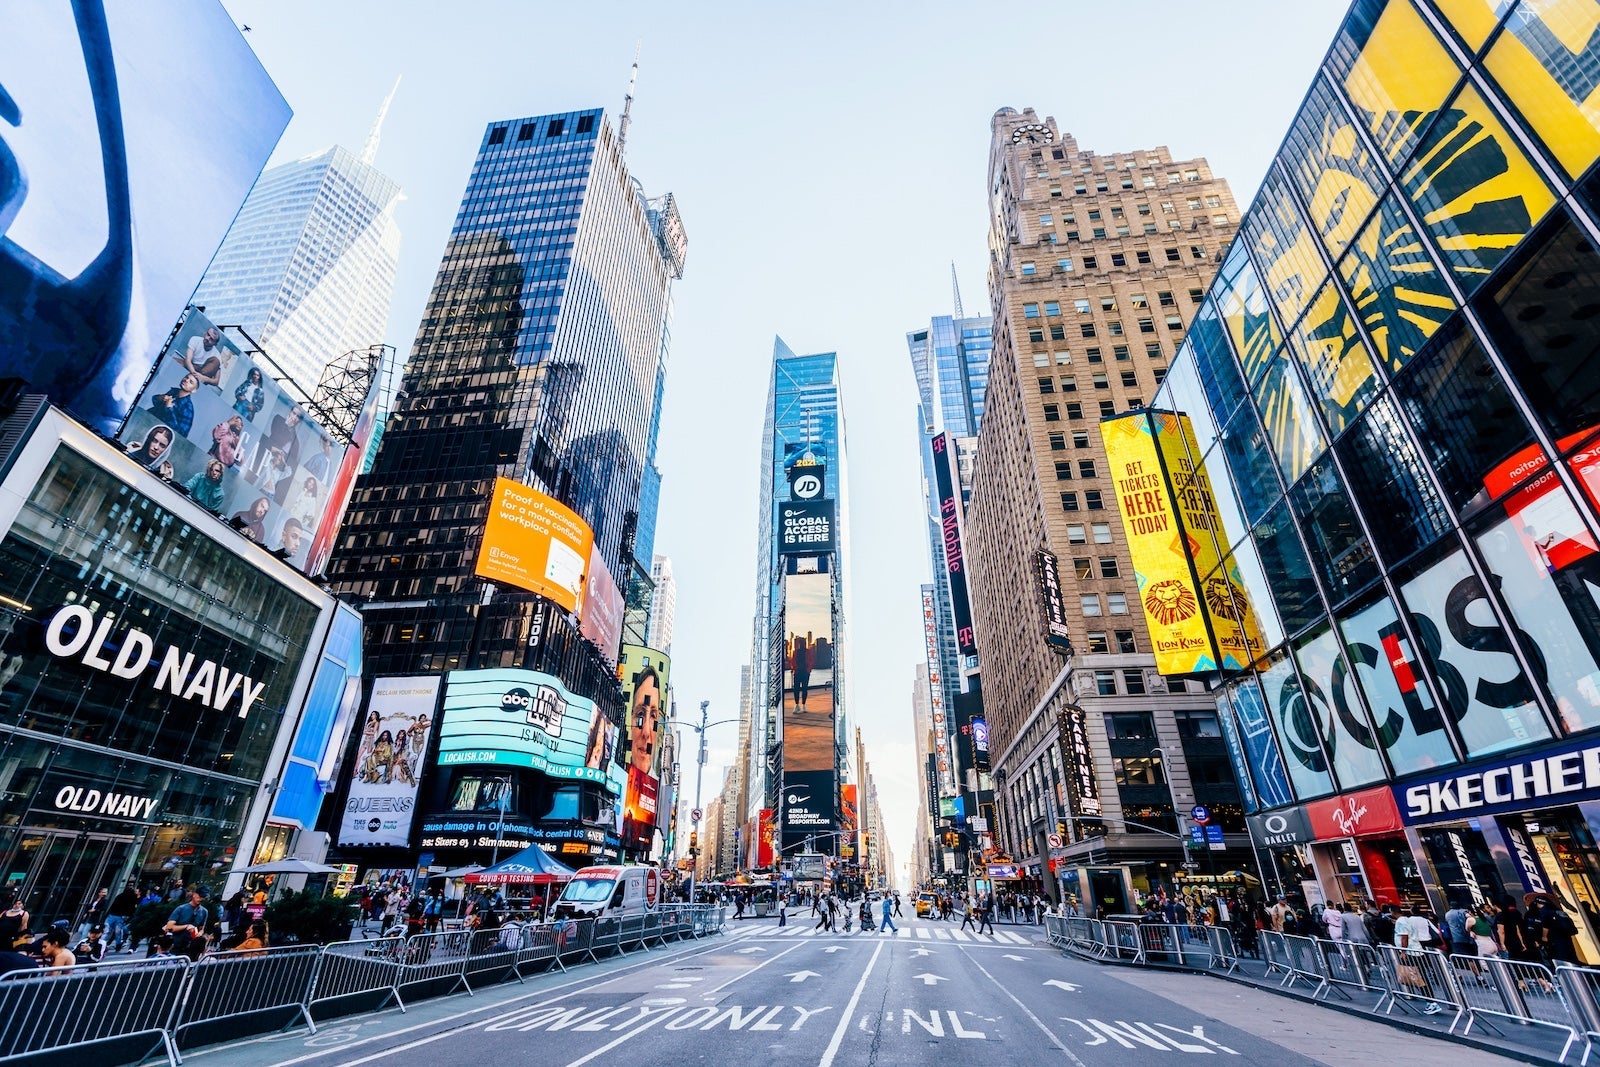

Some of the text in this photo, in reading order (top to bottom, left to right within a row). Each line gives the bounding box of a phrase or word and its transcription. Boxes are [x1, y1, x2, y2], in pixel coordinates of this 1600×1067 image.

[234, 431, 272, 477] GAP
[1126, 460, 1143, 476] GET
[798, 481, 817, 493] JD
[1118, 474, 1160, 494] TICKETS
[504, 489, 583, 536] Proof of vaccination
[1123, 489, 1166, 518] HERE
[500, 511, 549, 535] workplace
[501, 499, 517, 511] for
[527, 511, 551, 525] more
[552, 522, 582, 546] confident
[784, 517, 829, 526] GLOBAL
[784, 525, 829, 535] ACCESS
[1129, 513, 1169, 536] TODAY
[785, 533, 829, 544] IS HERE
[500, 551, 520, 563] Envoy
[529, 603, 542, 646] 1500
[46, 604, 265, 719] OLD NAVY
[1332, 573, 1548, 751] CBS
[502, 691, 530, 707] abc
[444, 751, 496, 763] LOCALISH.COM
[55, 785, 158, 818] OLD NAVY
[347, 797, 414, 814] QUEENS
[443, 822, 474, 832] damage
[477, 822, 486, 830] in
[545, 830, 572, 838] central
[573, 830, 584, 838] US
[1264, 833, 1296, 845] OAKLEY
[435, 837, 458, 847] Sixers
[478, 837, 519, 848] Simmons
[562, 842, 588, 854] ESPN
[1448, 831, 1486, 908] SKECHE
[664, 1006, 833, 1031] ONLY
